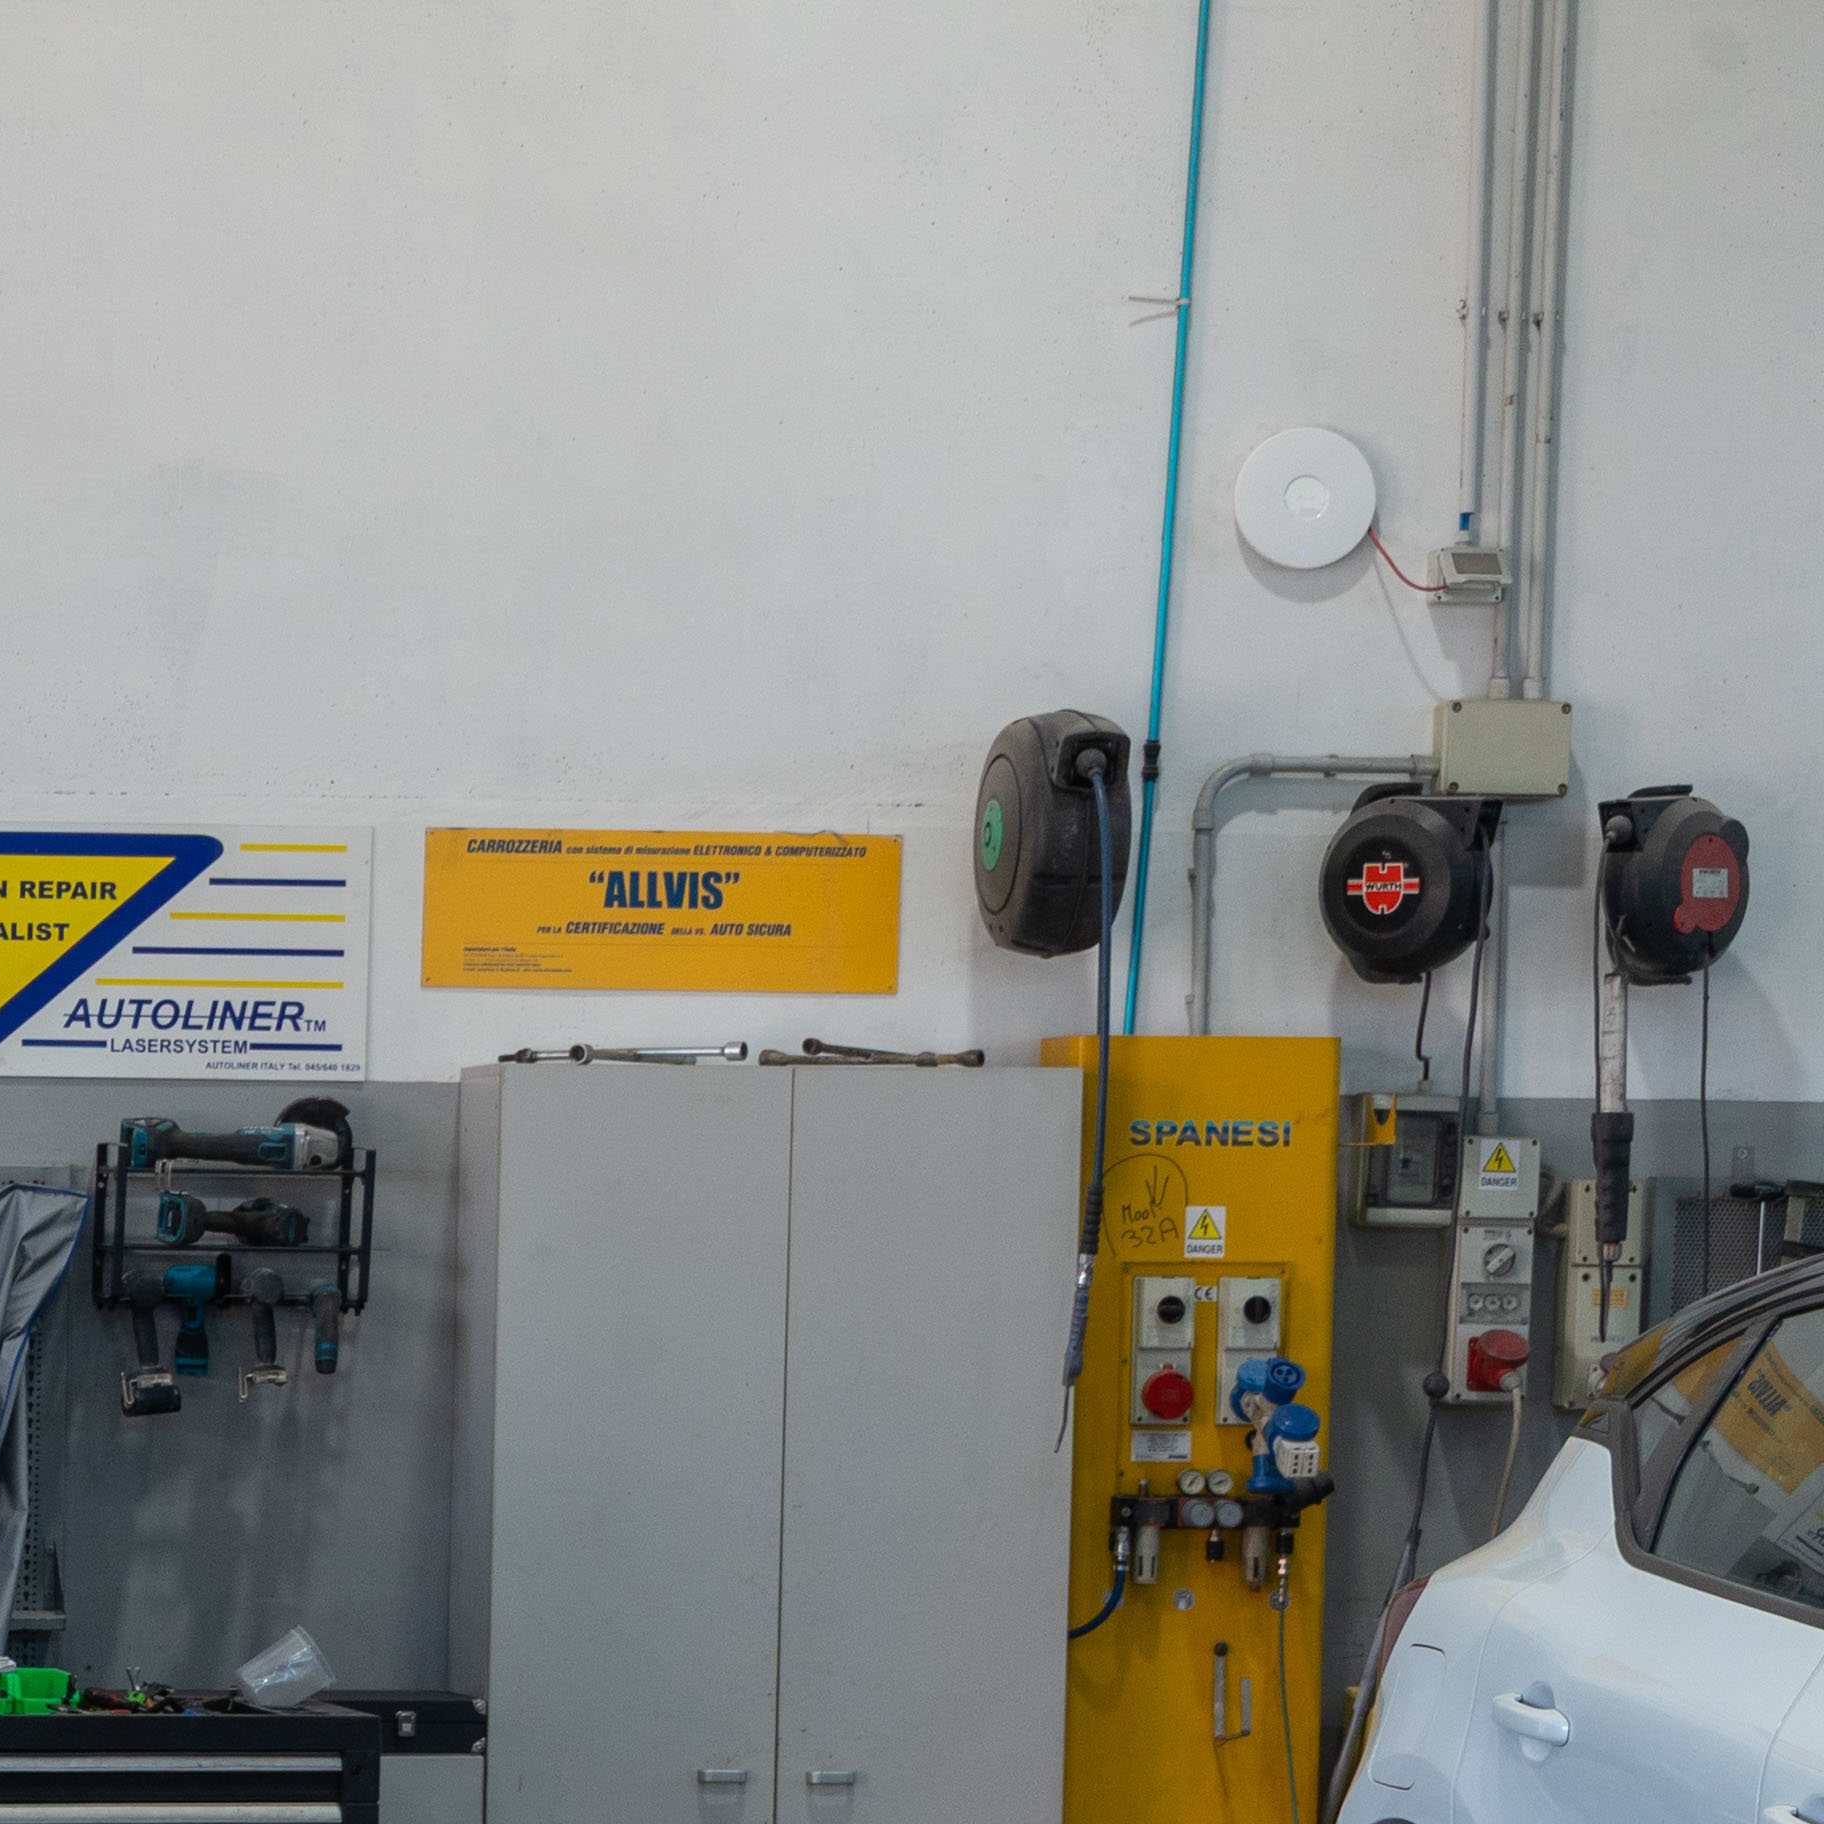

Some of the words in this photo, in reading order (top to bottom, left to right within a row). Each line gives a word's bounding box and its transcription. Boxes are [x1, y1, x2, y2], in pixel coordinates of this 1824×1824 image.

[466, 838, 563, 854] CARROZZERIA
[565, 846, 584, 855] con
[585, 845, 622, 855] sistema
[623, 845, 634, 855] di
[635, 845, 691, 856] misurazione
[692, 845, 762, 857] ELETTRONICO
[764, 846, 772, 857] &
[774, 845, 867, 858] COMPUTERIZZATO
[19, 880, 118, 900] REPAIR
[536, 926, 551, 934] PER
[552, 926, 562, 934] LA
[565, 921, 665, 935] CERTIFICAZIONE
[709, 922, 744, 936] AUTO
[746, 923, 792, 937] SICURA
[63, 997, 305, 1032] AUTOLINER
[110, 1038, 248, 1055] LASERSYSTEM
[205, 1061, 258, 1070] AUTOLINER
[260, 1062, 285, 1071] ITALY
[288, 1063, 301, 1071] Tel.
[1129, 1119, 1292, 1148] SPANESI
[1480, 1176, 1517, 1188] DANGER
[1121, 1217, 1180, 1249] 32A
[1186, 1243, 1223, 1255] DANGER
